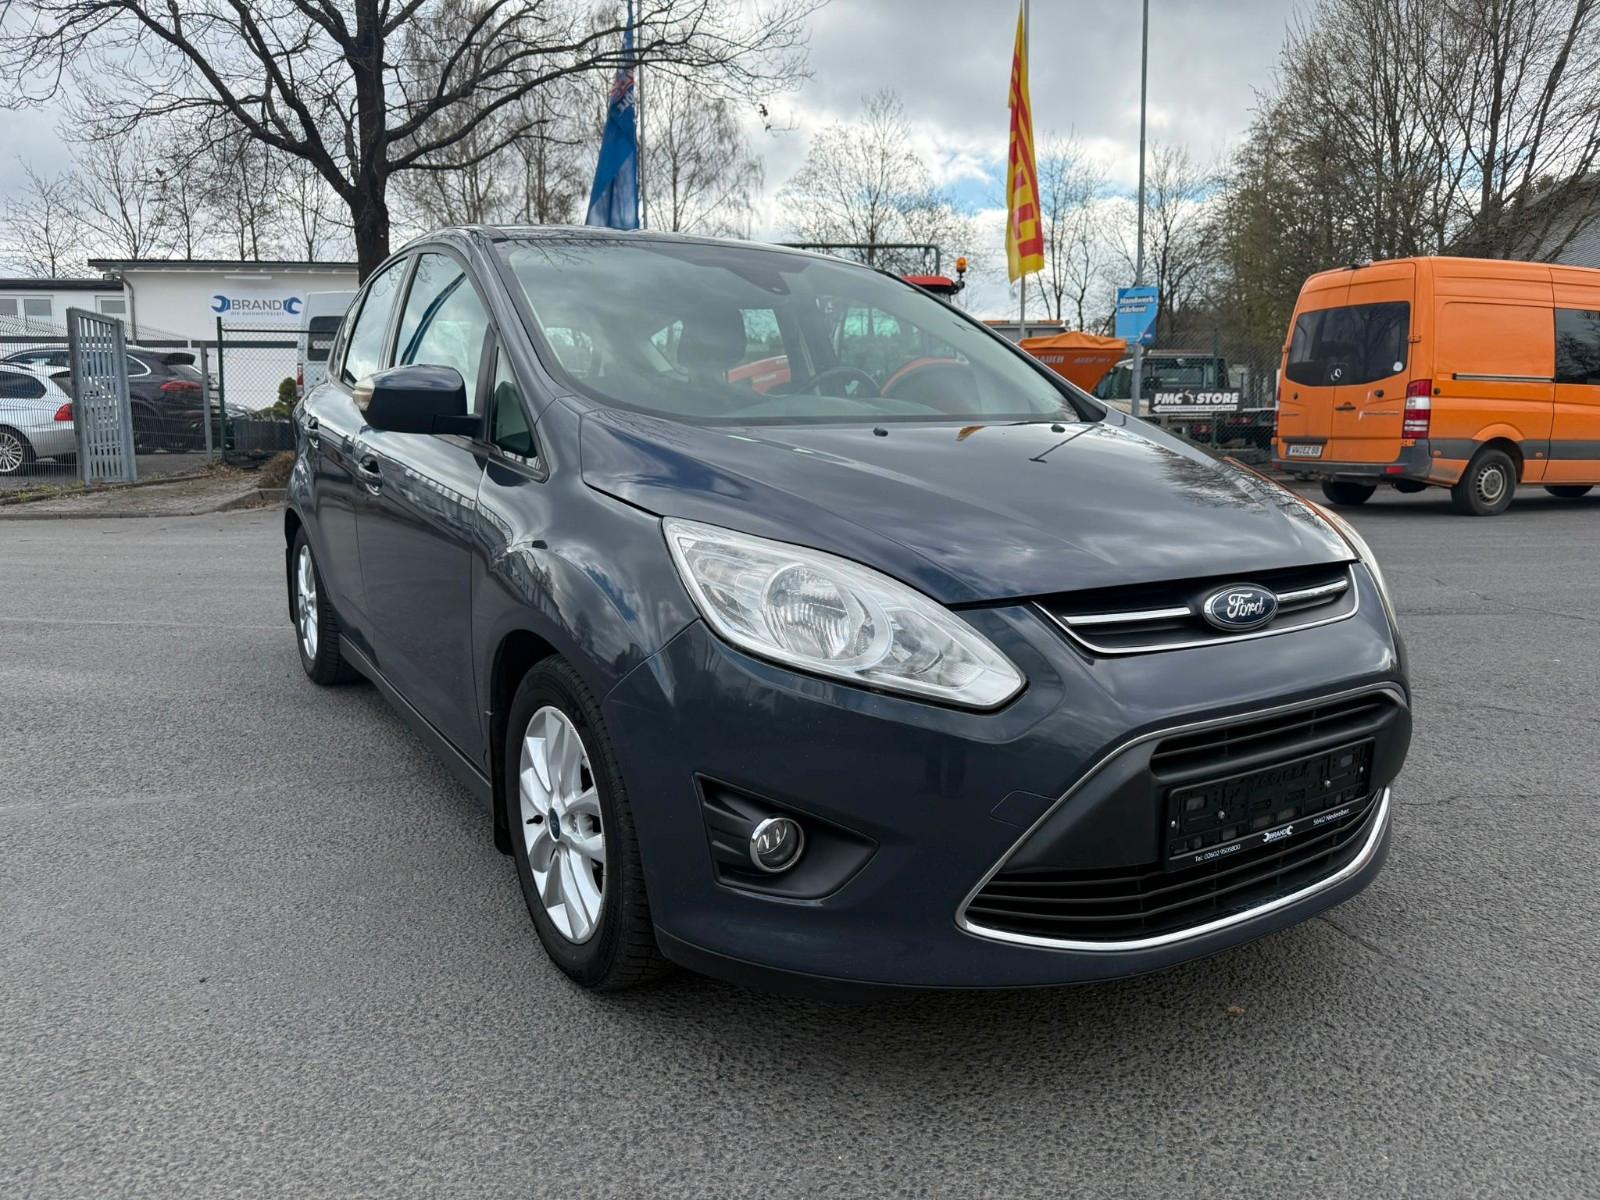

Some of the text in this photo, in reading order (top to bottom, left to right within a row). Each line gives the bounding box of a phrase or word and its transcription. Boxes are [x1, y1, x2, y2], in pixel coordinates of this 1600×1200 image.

[231, 299, 282, 311] BRAND
[1154, 392, 1239, 404] FMC STORE
[1227, 593, 1265, 618] Ford
